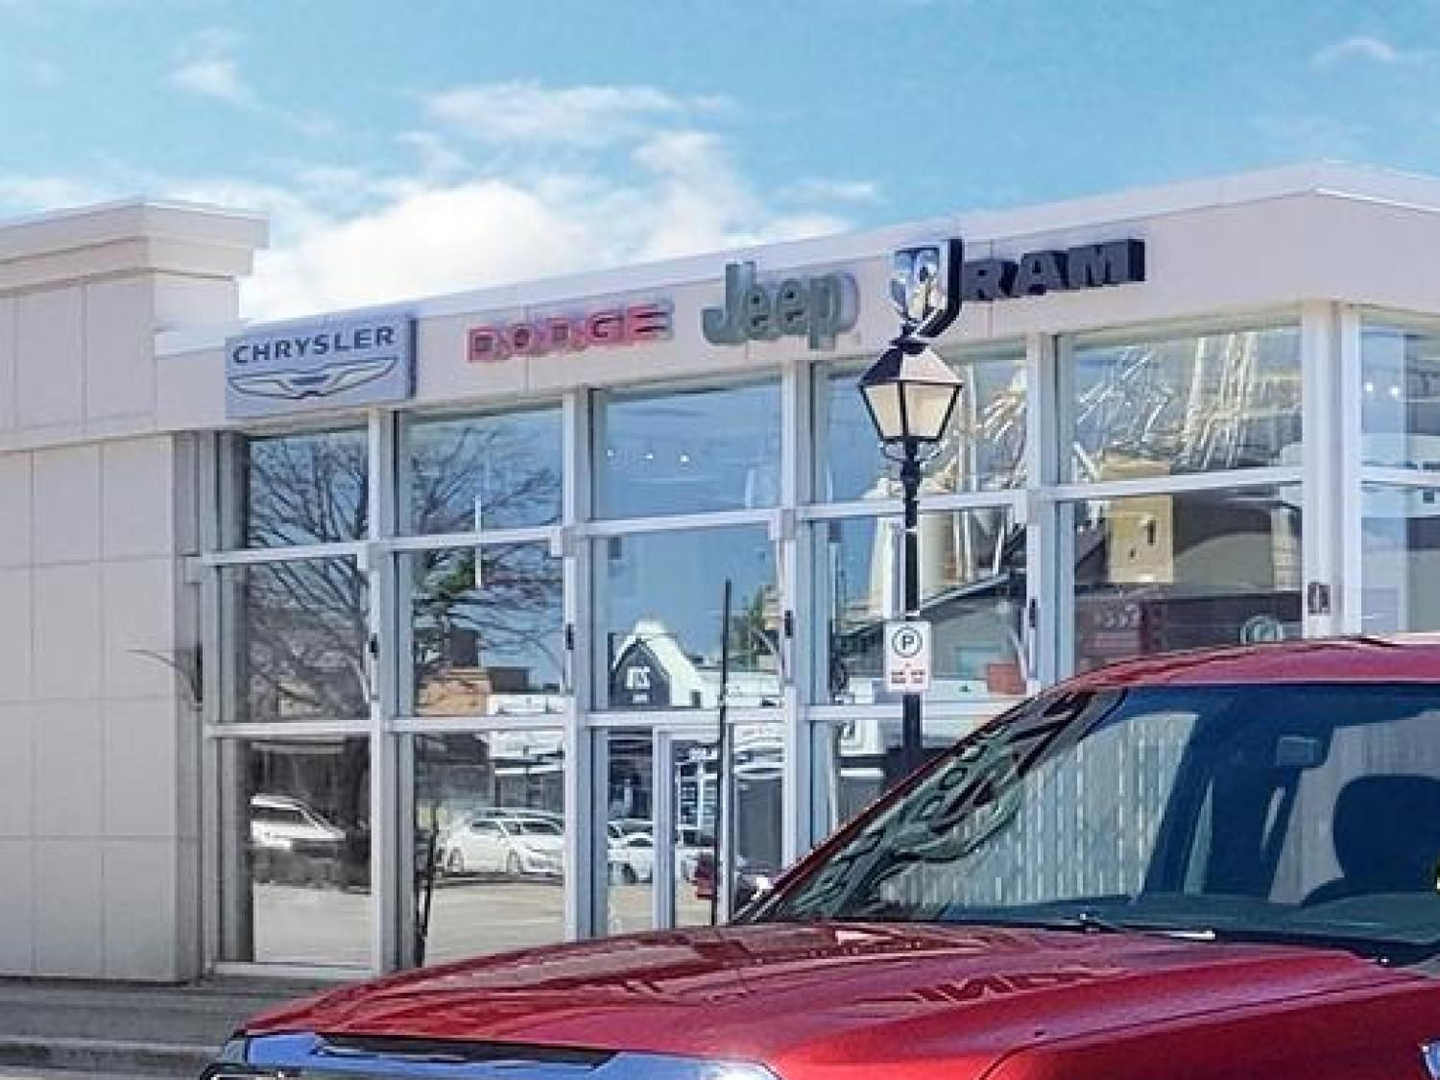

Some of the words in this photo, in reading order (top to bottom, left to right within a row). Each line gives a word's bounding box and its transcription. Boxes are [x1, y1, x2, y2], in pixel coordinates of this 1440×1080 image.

[960, 238, 1146, 302] RAM
[467, 299, 674, 362] DODGE
[702, 261, 858, 350] Jeep
[232, 325, 396, 364] CHRYSLER
